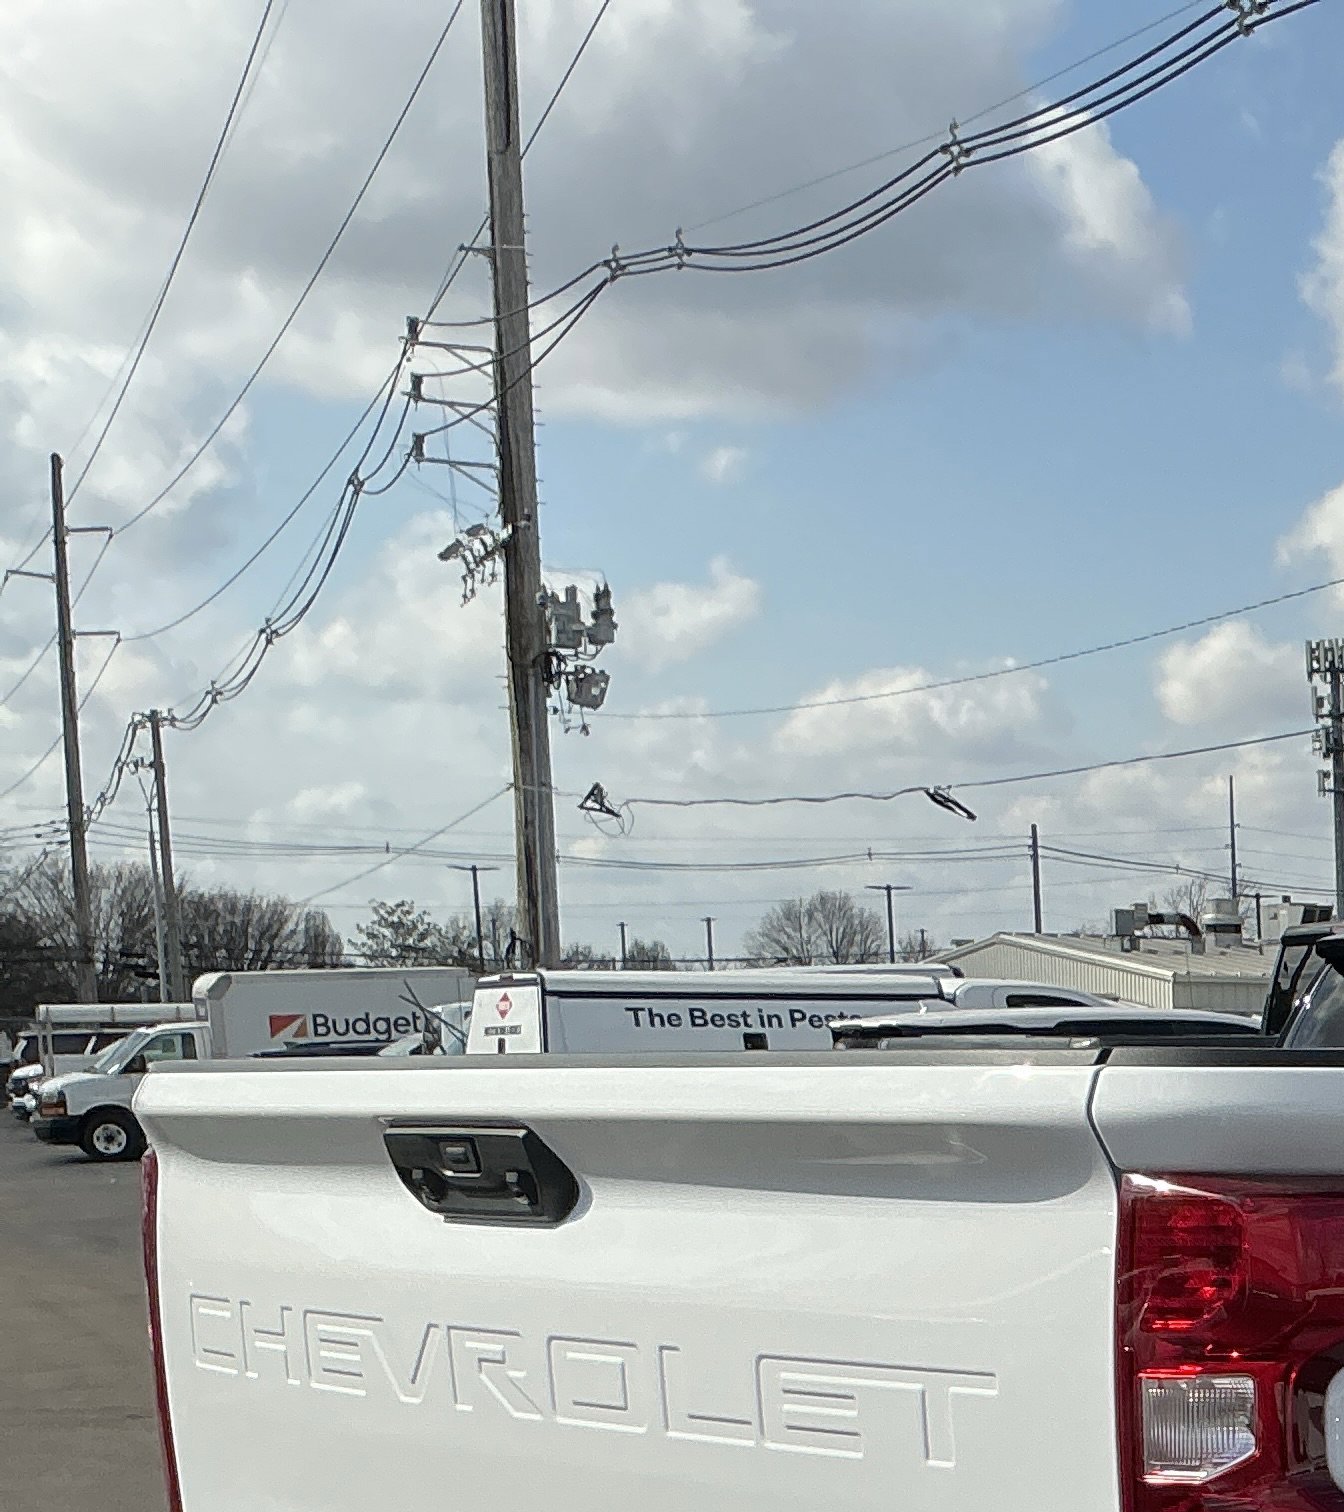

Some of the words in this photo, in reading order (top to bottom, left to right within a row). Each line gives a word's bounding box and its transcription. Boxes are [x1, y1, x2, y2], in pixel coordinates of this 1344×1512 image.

[311, 1011, 423, 1041] Budget
[625, 1006, 682, 1028] The
[688, 1007, 753, 1028] Best
[757, 1007, 784, 1029] in
[788, 1008, 863, 1029] Pes
[187, 1290, 1001, 1469] CHEVROLET
